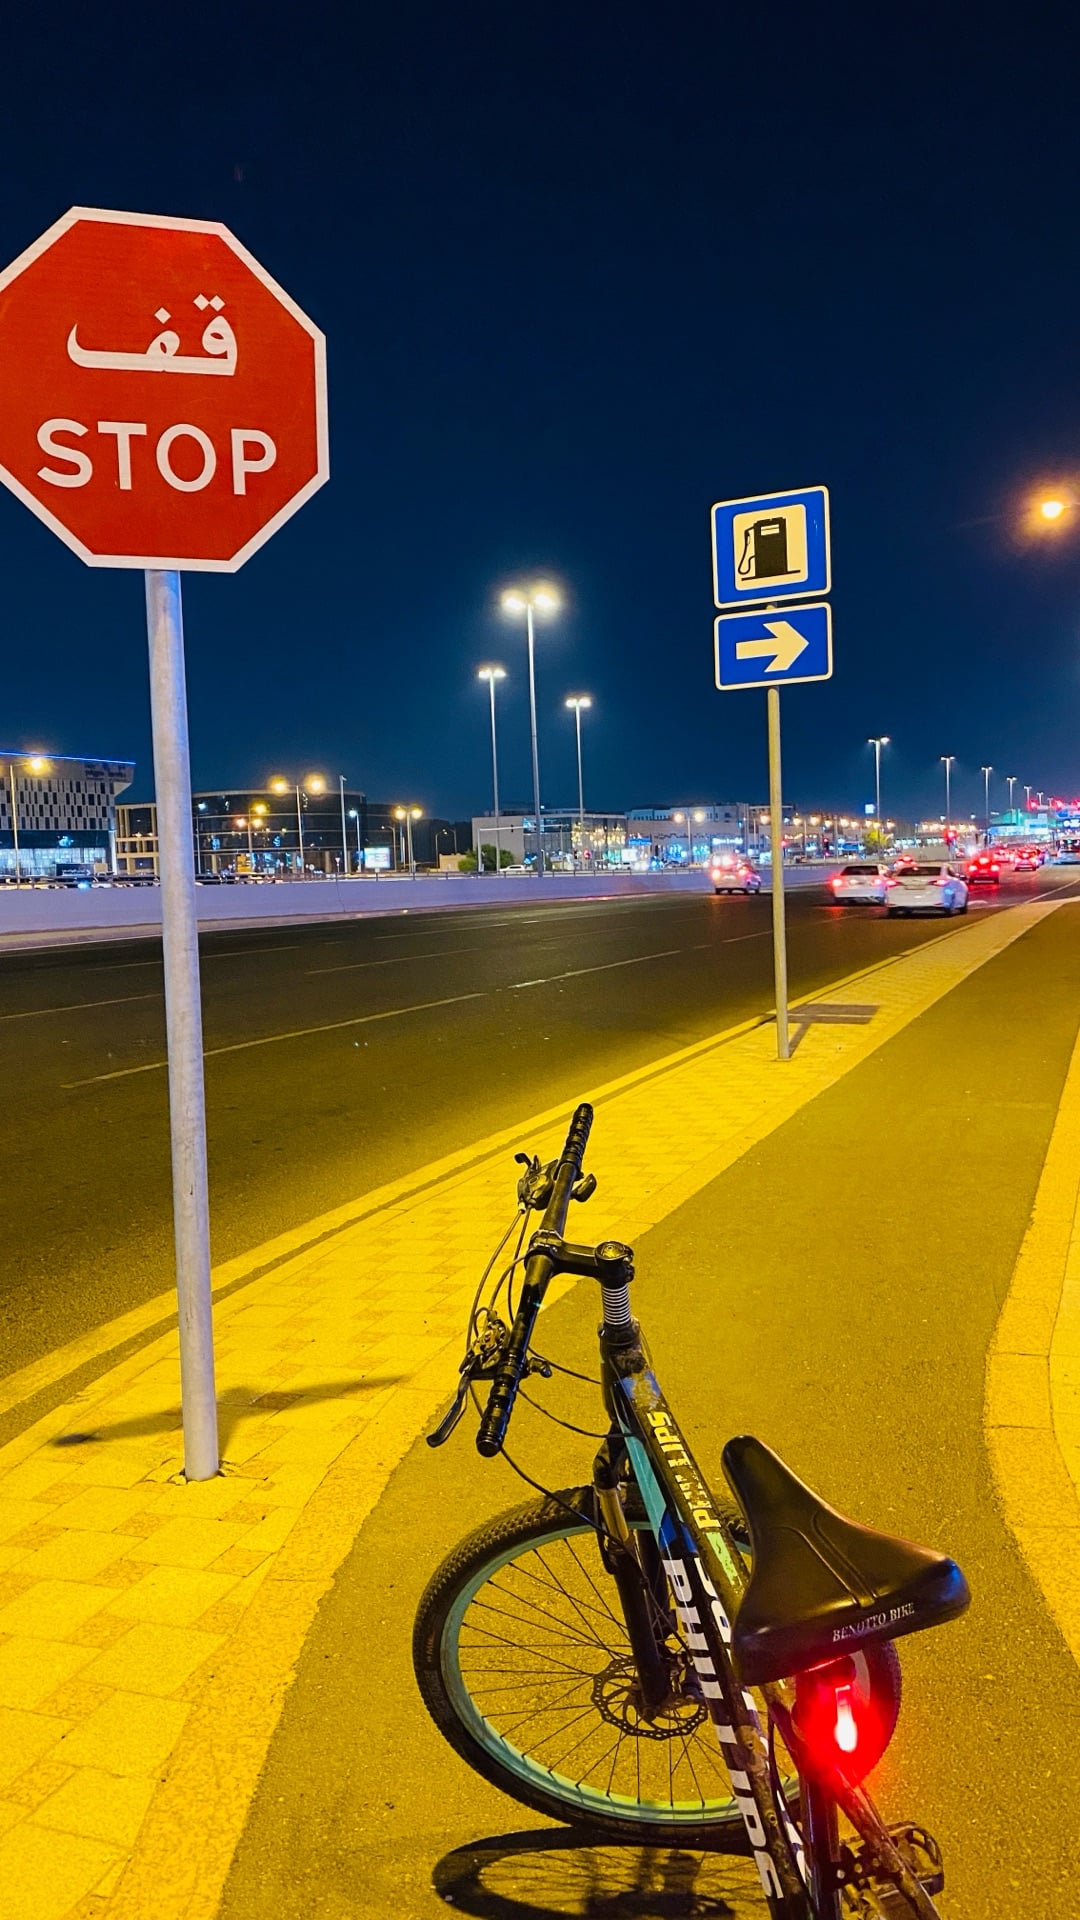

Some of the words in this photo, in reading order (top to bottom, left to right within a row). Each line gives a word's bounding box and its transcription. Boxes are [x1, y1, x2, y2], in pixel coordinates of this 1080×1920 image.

[67, 294, 238, 376] قف
[36, 418, 277, 495] STOP
[832, 1612, 887, 1642] BENOTTO
[889, 1602, 915, 1621] BIKE
